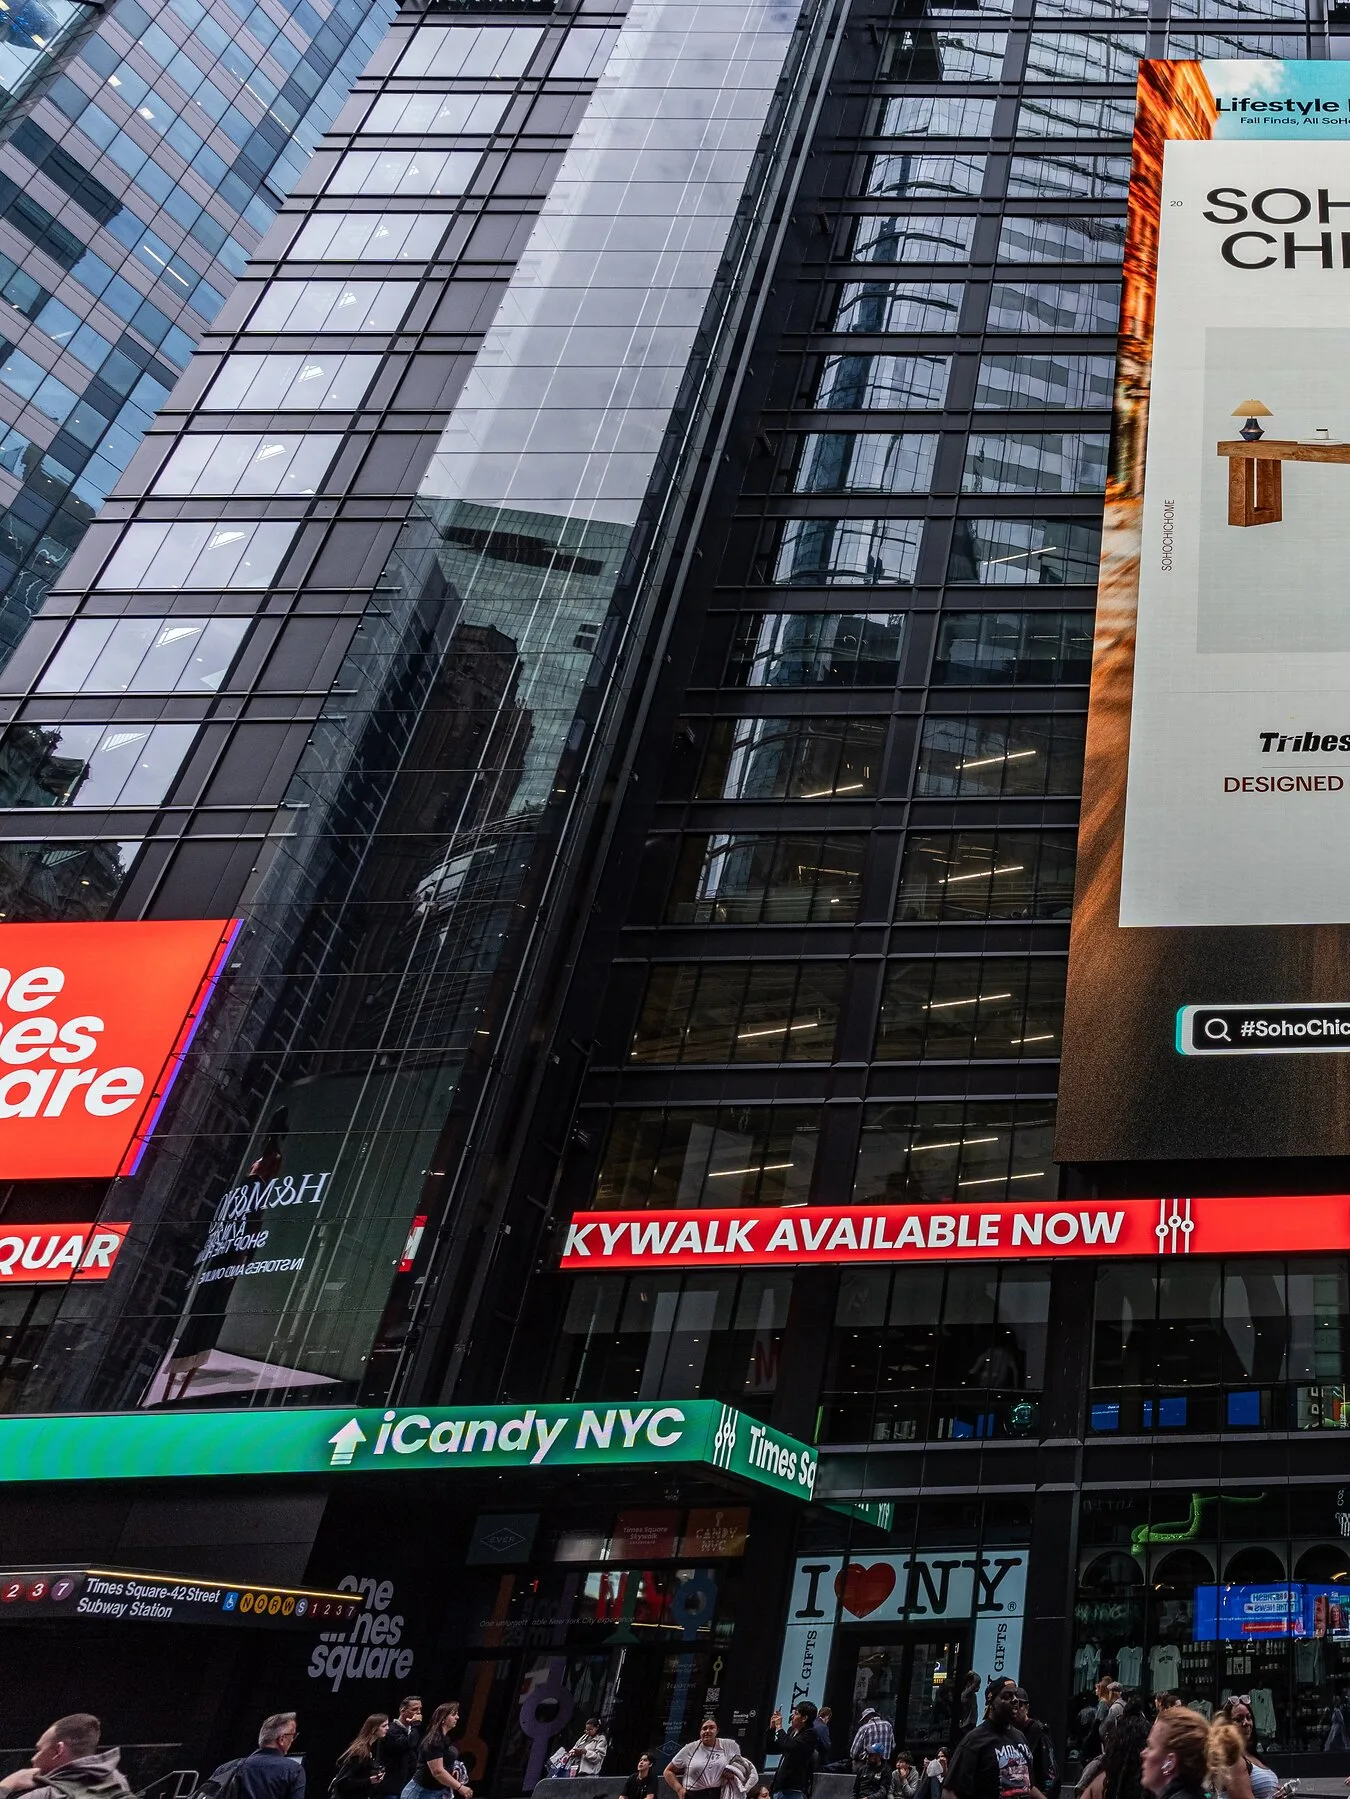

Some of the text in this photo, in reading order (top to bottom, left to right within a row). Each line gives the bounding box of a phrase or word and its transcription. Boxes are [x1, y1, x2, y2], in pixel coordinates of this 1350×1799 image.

[1215, 97, 1340, 115] Lifestyle
[1240, 117, 1262, 125] Fall
[1263, 117, 1300, 126] Finds,
[1303, 117, 1319, 125] All
[1169, 200, 1184, 208] 20
[1161, 499, 1176, 572] SOHOCHICHOME
[1223, 775, 1344, 793] DESIGNED
[0, 1015, 105, 1065] es
[563, 1211, 1125, 1257] KYWALK AVAILABLE NOW
[374, 1407, 686, 1465] iCandy NYC
[748, 1425, 797, 1481] Times
[7, 1582, 69, 1598] 2 3 7
[77, 1597, 172, 1618] Subway Station
[86, 1577, 124, 1596] Times
[795, 1564, 831, 1618] I
[323, 1603, 332, 1615] 2
[335, 1605, 343, 1617] 3
[308, 1644, 414, 1693] square
[801, 1630, 818, 1680] GIFTS
[994, 1623, 1008, 1672] GIFTS
